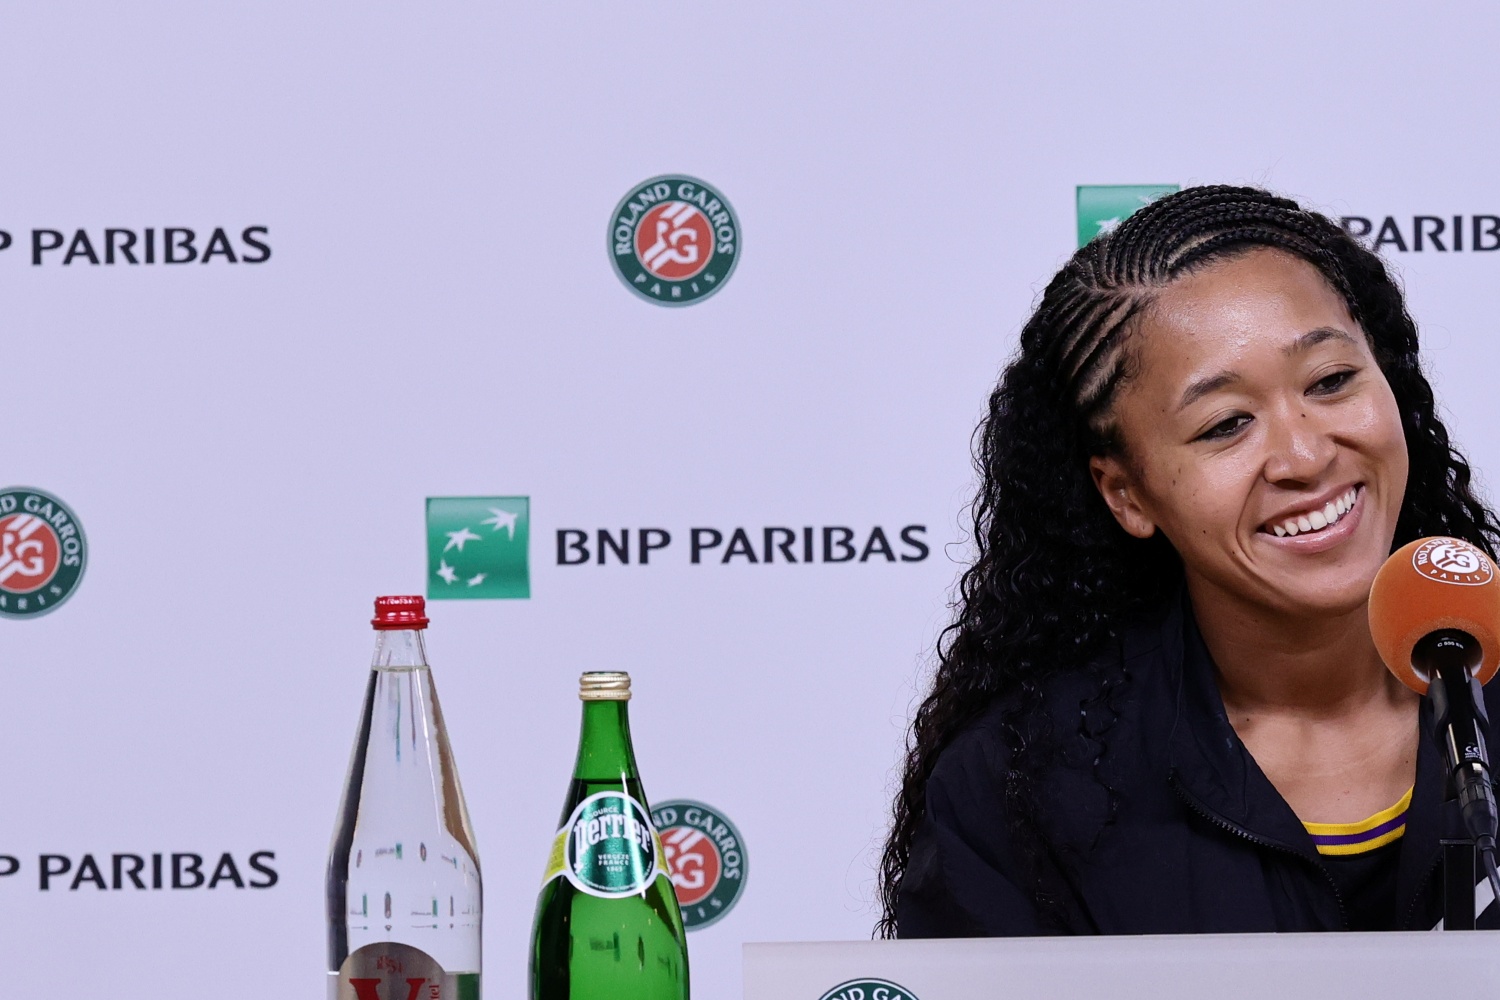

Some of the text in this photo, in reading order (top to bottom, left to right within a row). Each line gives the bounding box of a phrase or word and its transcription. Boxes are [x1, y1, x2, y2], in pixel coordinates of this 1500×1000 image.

[615, 183, 735, 255] ROLAND GARROS
[32, 226, 271, 266] PARIBAS
[634, 272, 716, 298] PARIS
[24, 495, 81, 567] GARROS
[556, 525, 930, 565] BNP PARIBAS
[1418, 538, 1452, 566] ROLAND
[1430, 569, 1481, 581] PARIS
[684, 808, 741, 880] GARROS
[39, 852, 279, 891] PARIBAS
